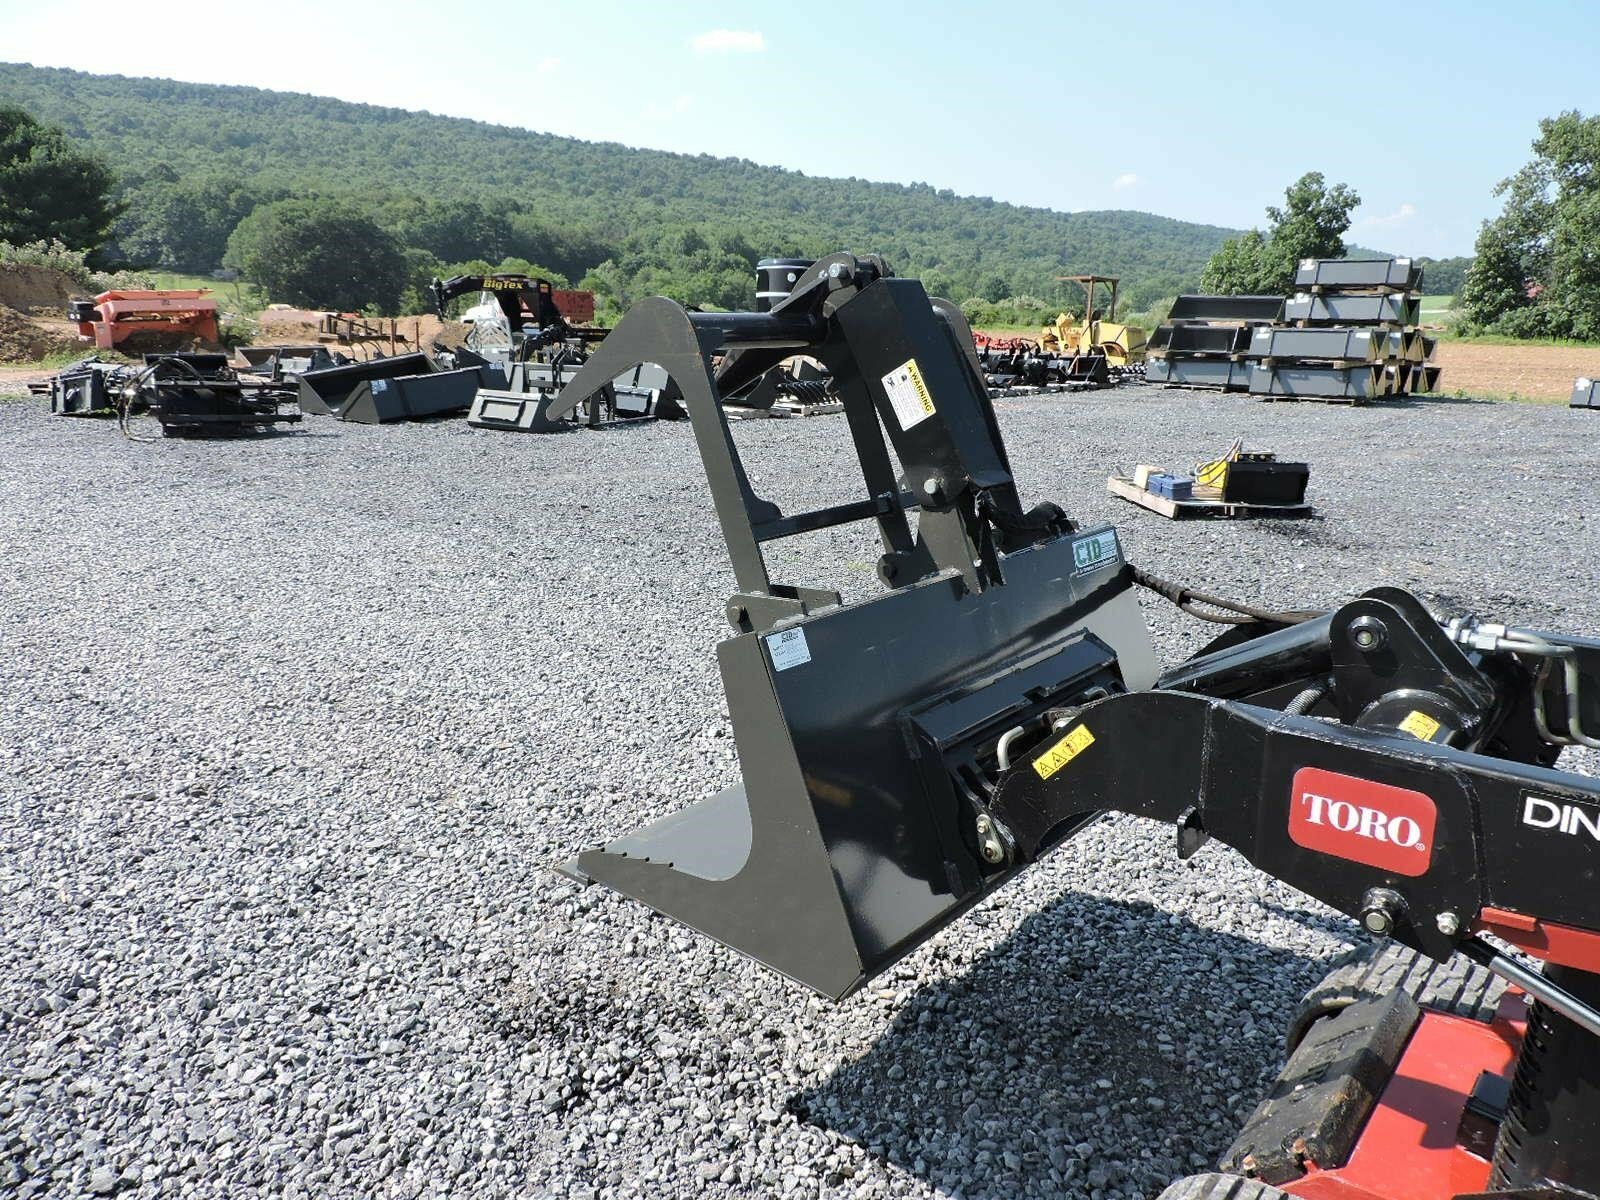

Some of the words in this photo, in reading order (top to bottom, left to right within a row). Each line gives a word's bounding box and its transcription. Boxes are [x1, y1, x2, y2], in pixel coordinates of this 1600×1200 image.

[911, 371, 933, 412] WARNING
[1075, 538, 1102, 567] CID
[1302, 792, 1422, 848] TORO
